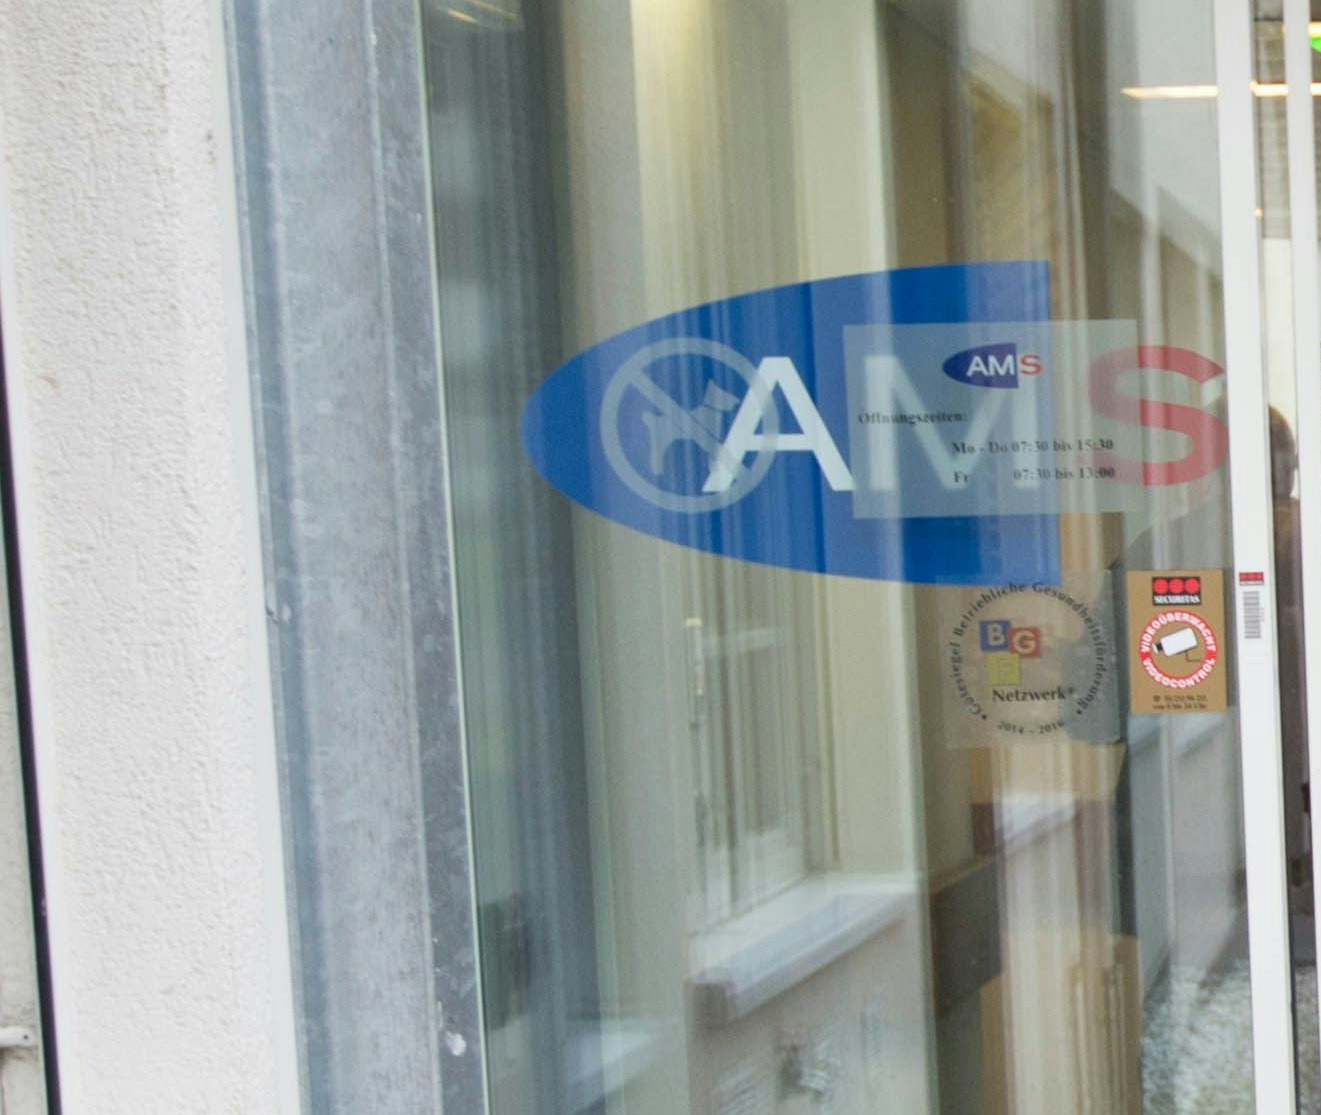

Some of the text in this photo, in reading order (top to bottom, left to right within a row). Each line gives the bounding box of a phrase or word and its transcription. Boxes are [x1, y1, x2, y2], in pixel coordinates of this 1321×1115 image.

[966, 354, 1042, 377] AMS
[702, 345, 1228, 492] AMS
[952, 442, 976, 455] Mo
[988, 441, 1008, 454] Do
[1053, 440, 1072, 452] bis
[953, 471, 970, 484] Fr
[1055, 467, 1074, 480] bis
